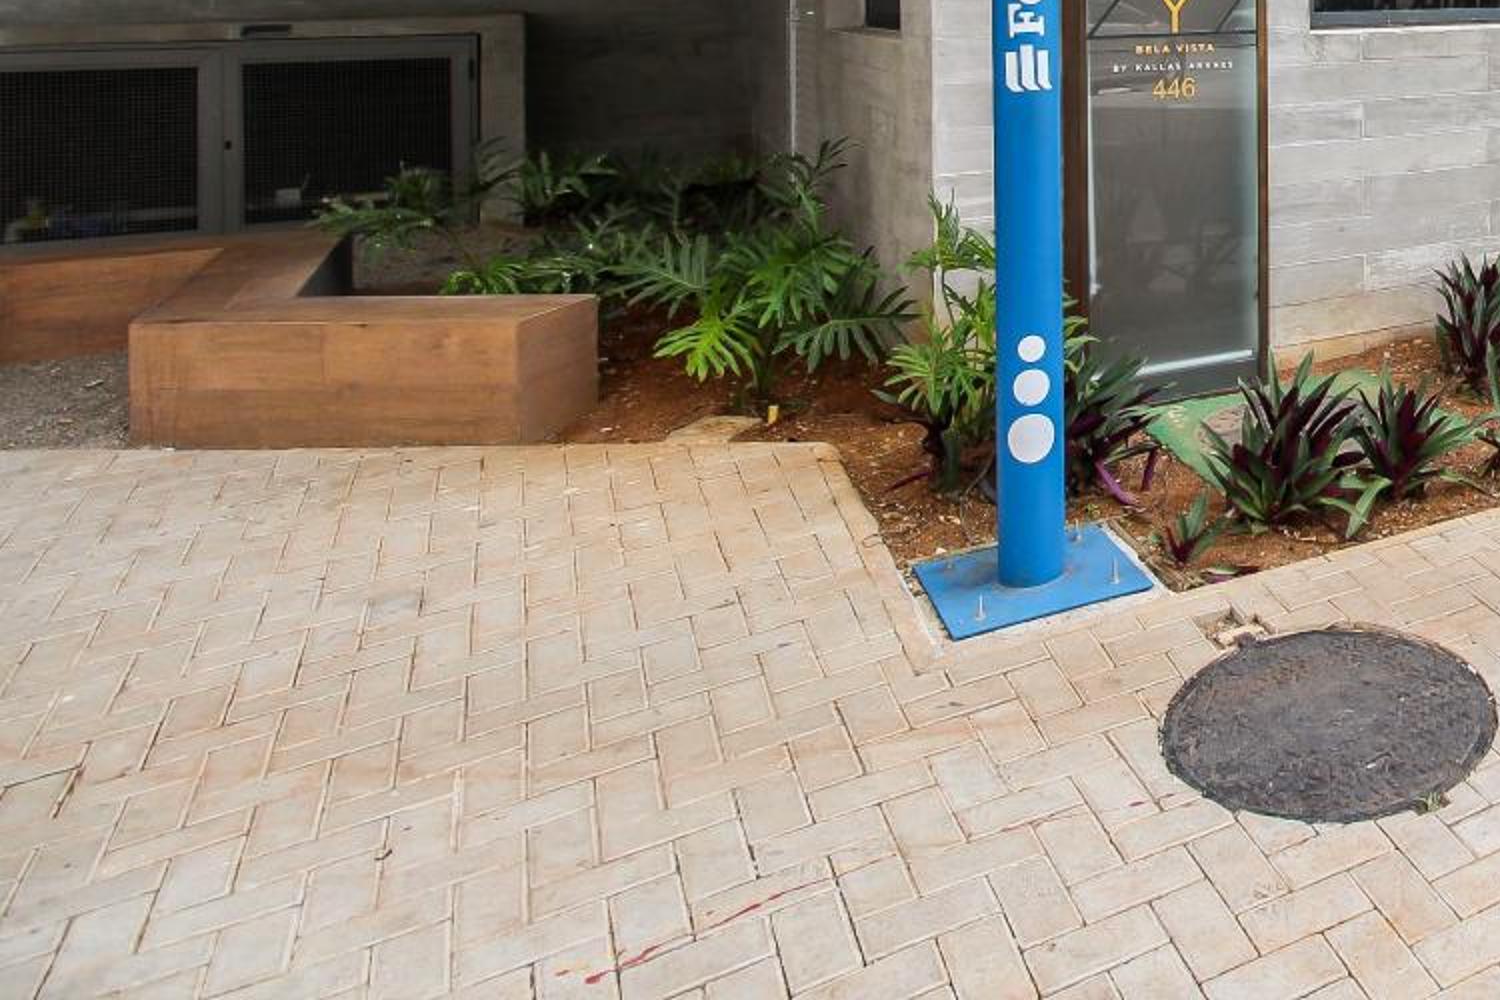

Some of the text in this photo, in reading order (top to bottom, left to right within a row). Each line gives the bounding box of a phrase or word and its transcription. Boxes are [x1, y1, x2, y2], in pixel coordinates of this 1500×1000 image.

[1135, 44, 1170, 54] BELA
[1176, 43, 1215, 53] VISTA
[1152, 77, 1195, 99] 446
